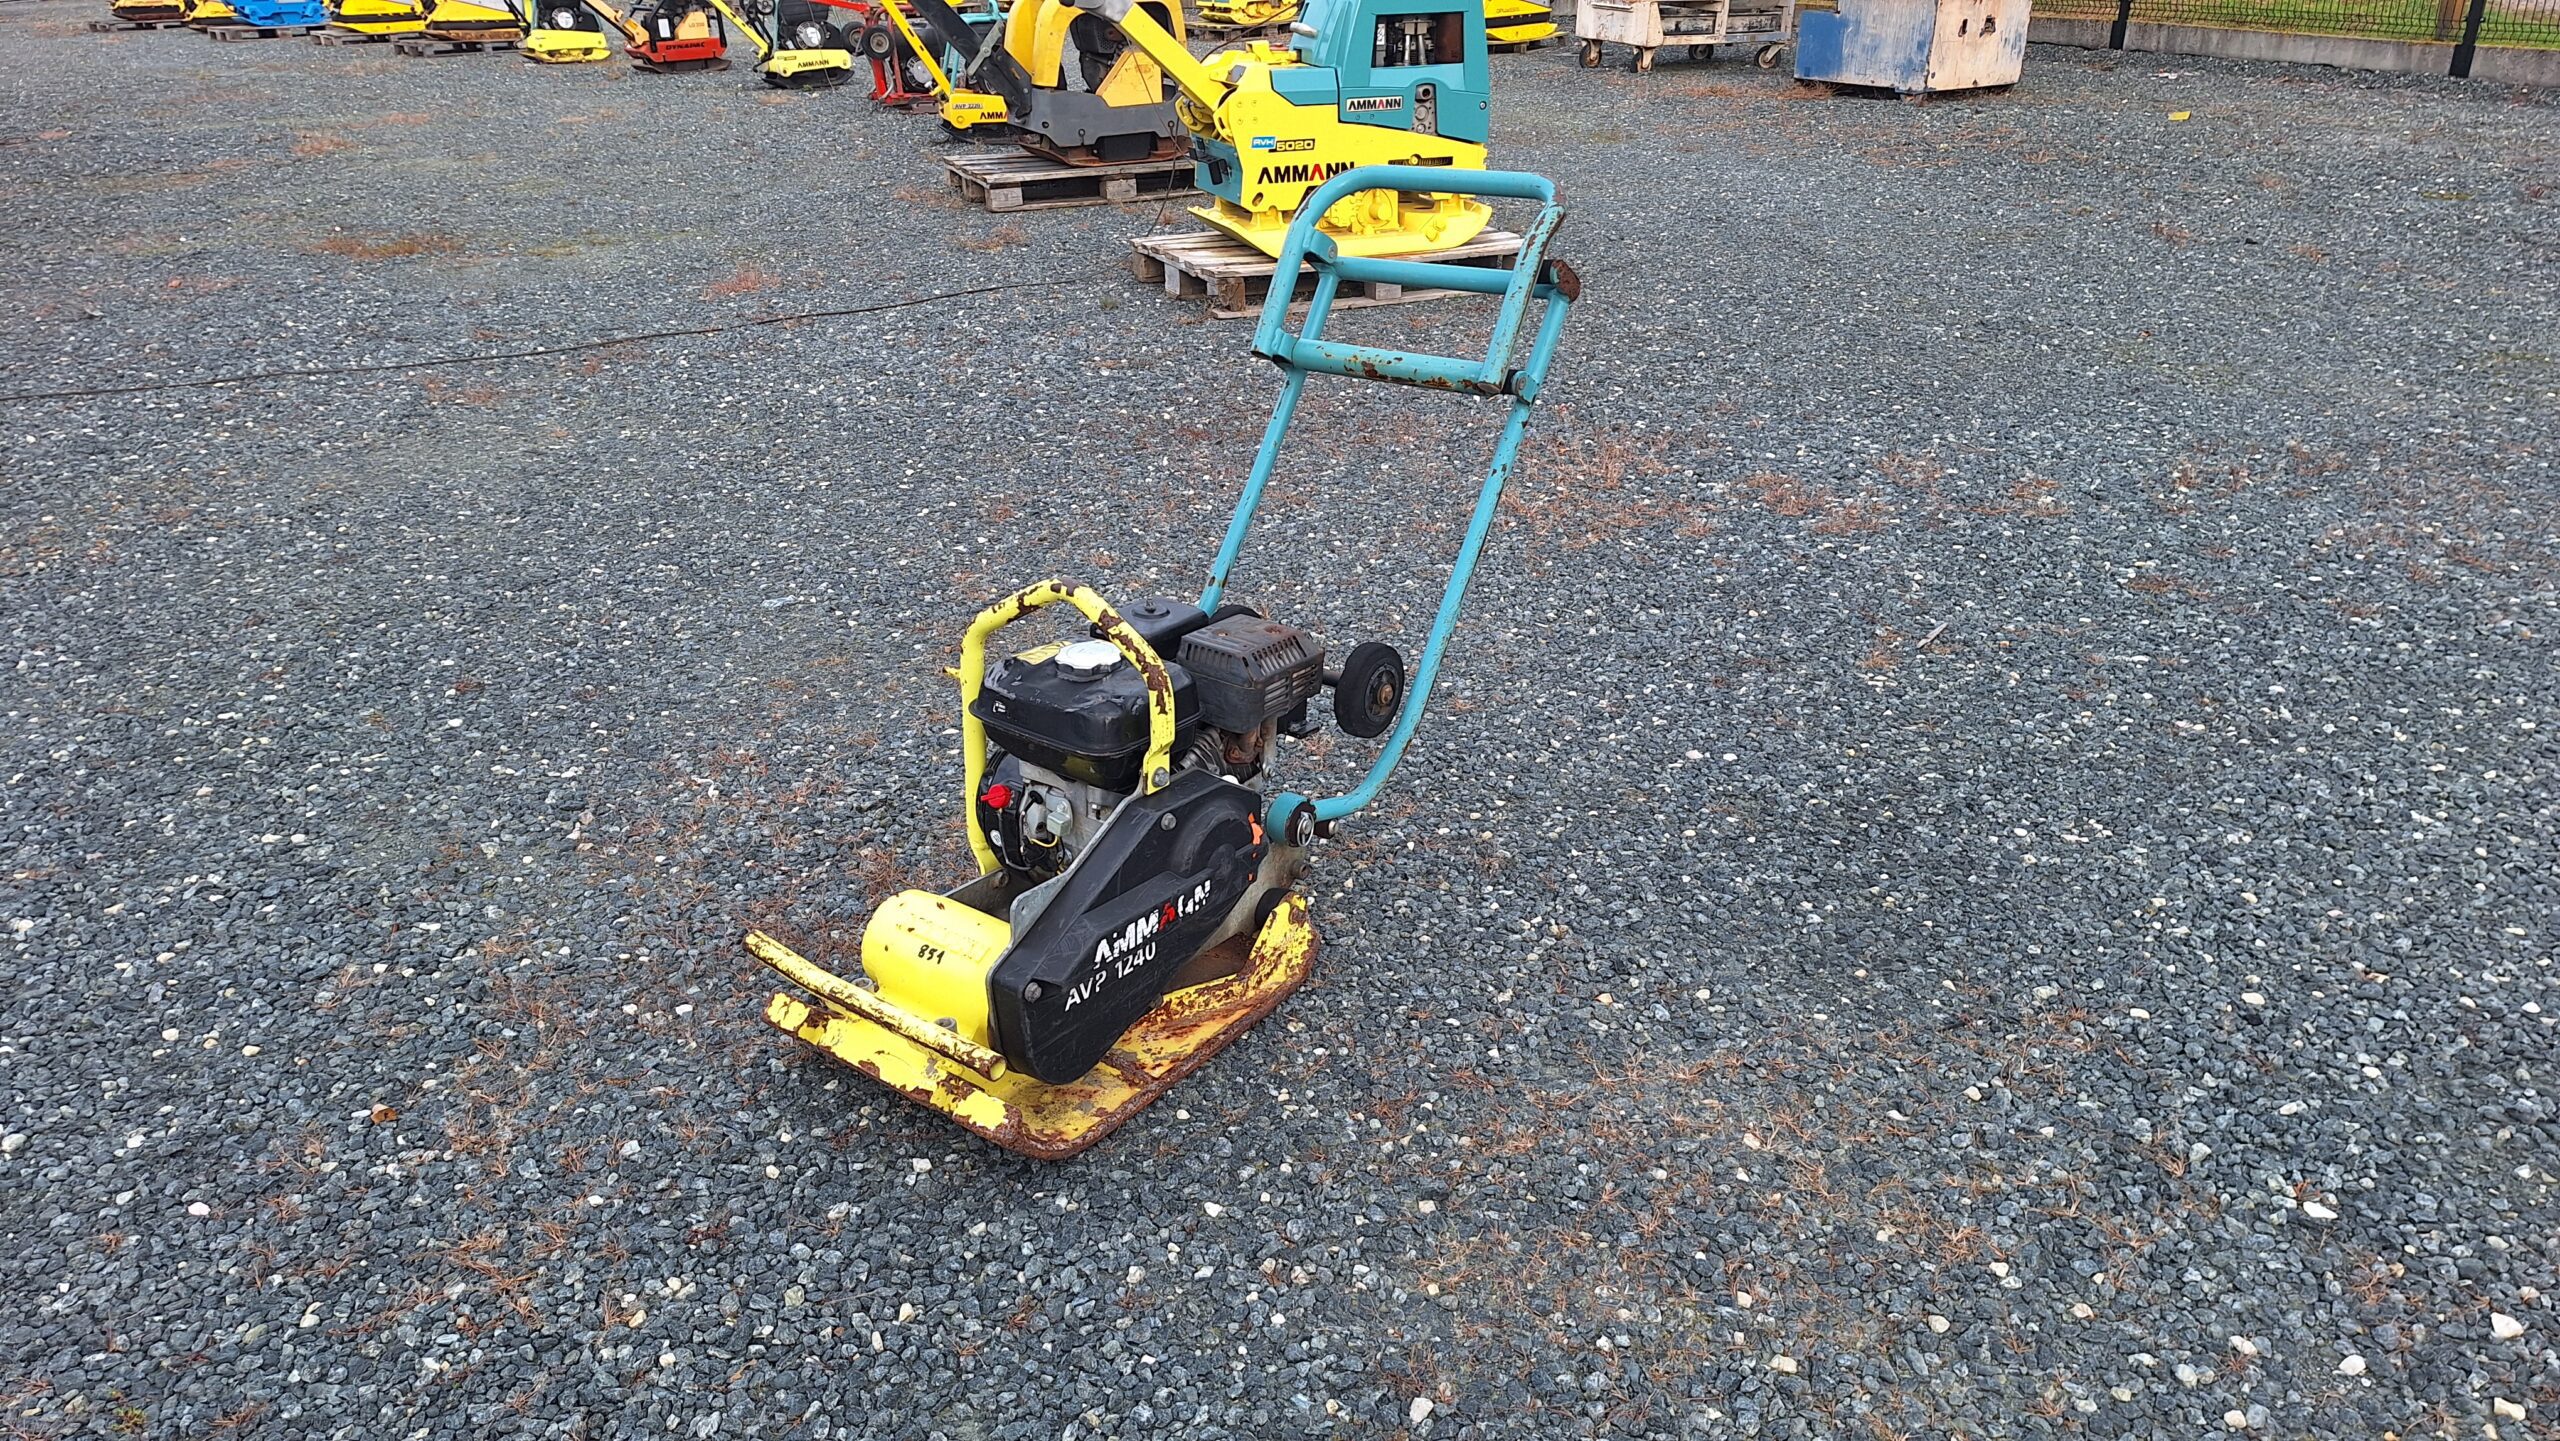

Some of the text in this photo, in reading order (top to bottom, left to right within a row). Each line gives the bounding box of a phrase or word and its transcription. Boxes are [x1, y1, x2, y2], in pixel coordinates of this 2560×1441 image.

[666, 42, 705, 50] DYNAPAC
[797, 59, 830, 69] AMMANN
[1347, 98, 1402, 111] AMMANN
[1276, 140, 1314, 152] 5020
